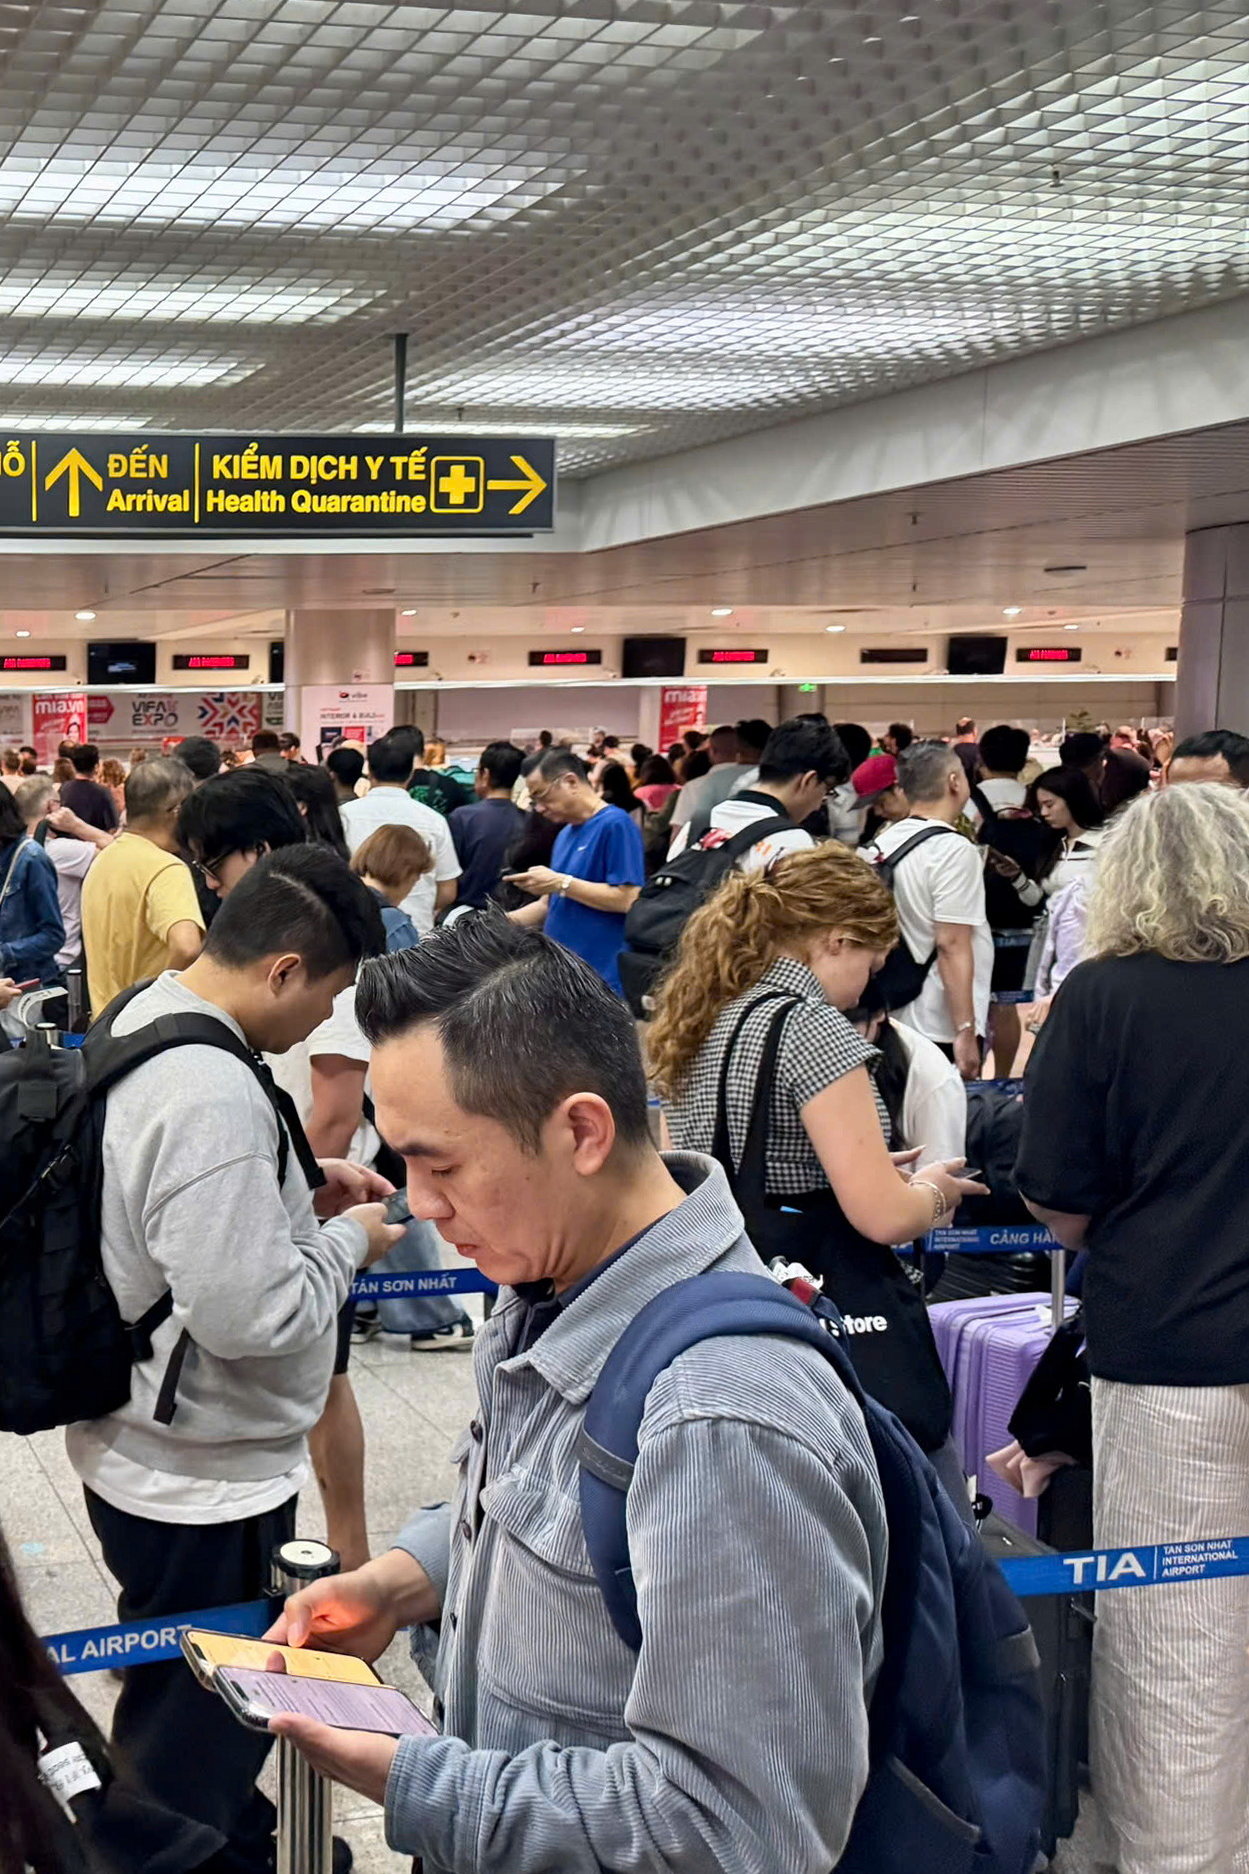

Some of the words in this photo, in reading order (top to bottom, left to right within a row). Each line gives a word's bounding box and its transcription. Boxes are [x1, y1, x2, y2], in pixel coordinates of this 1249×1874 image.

[107, 444, 168, 479] ĐẾN
[212, 443, 281, 480] KIỂM
[289, 456, 358, 485] DỊCH
[364, 456, 385, 480] Y
[391, 447, 427, 481] TẾ
[106, 488, 190, 513] Arrival
[207, 489, 285, 514] Health
[291, 489, 427, 515] Quarantine
[35, 700, 85, 714] mia.vn
[132, 712, 179, 726] EXPO
[383, 1279, 415, 1292] SƠN
[418, 1273, 458, 1291] NHẤT
[1163, 1545, 1182, 1555] TAN
[1184, 1542, 1205, 1553] SON
[1207, 1539, 1233, 1550] NHAT
[1162, 1550, 1239, 1566] INTERNATIONAL
[1063, 1552, 1146, 1584] TIA
[1162, 1564, 1206, 1577] AIRPORT
